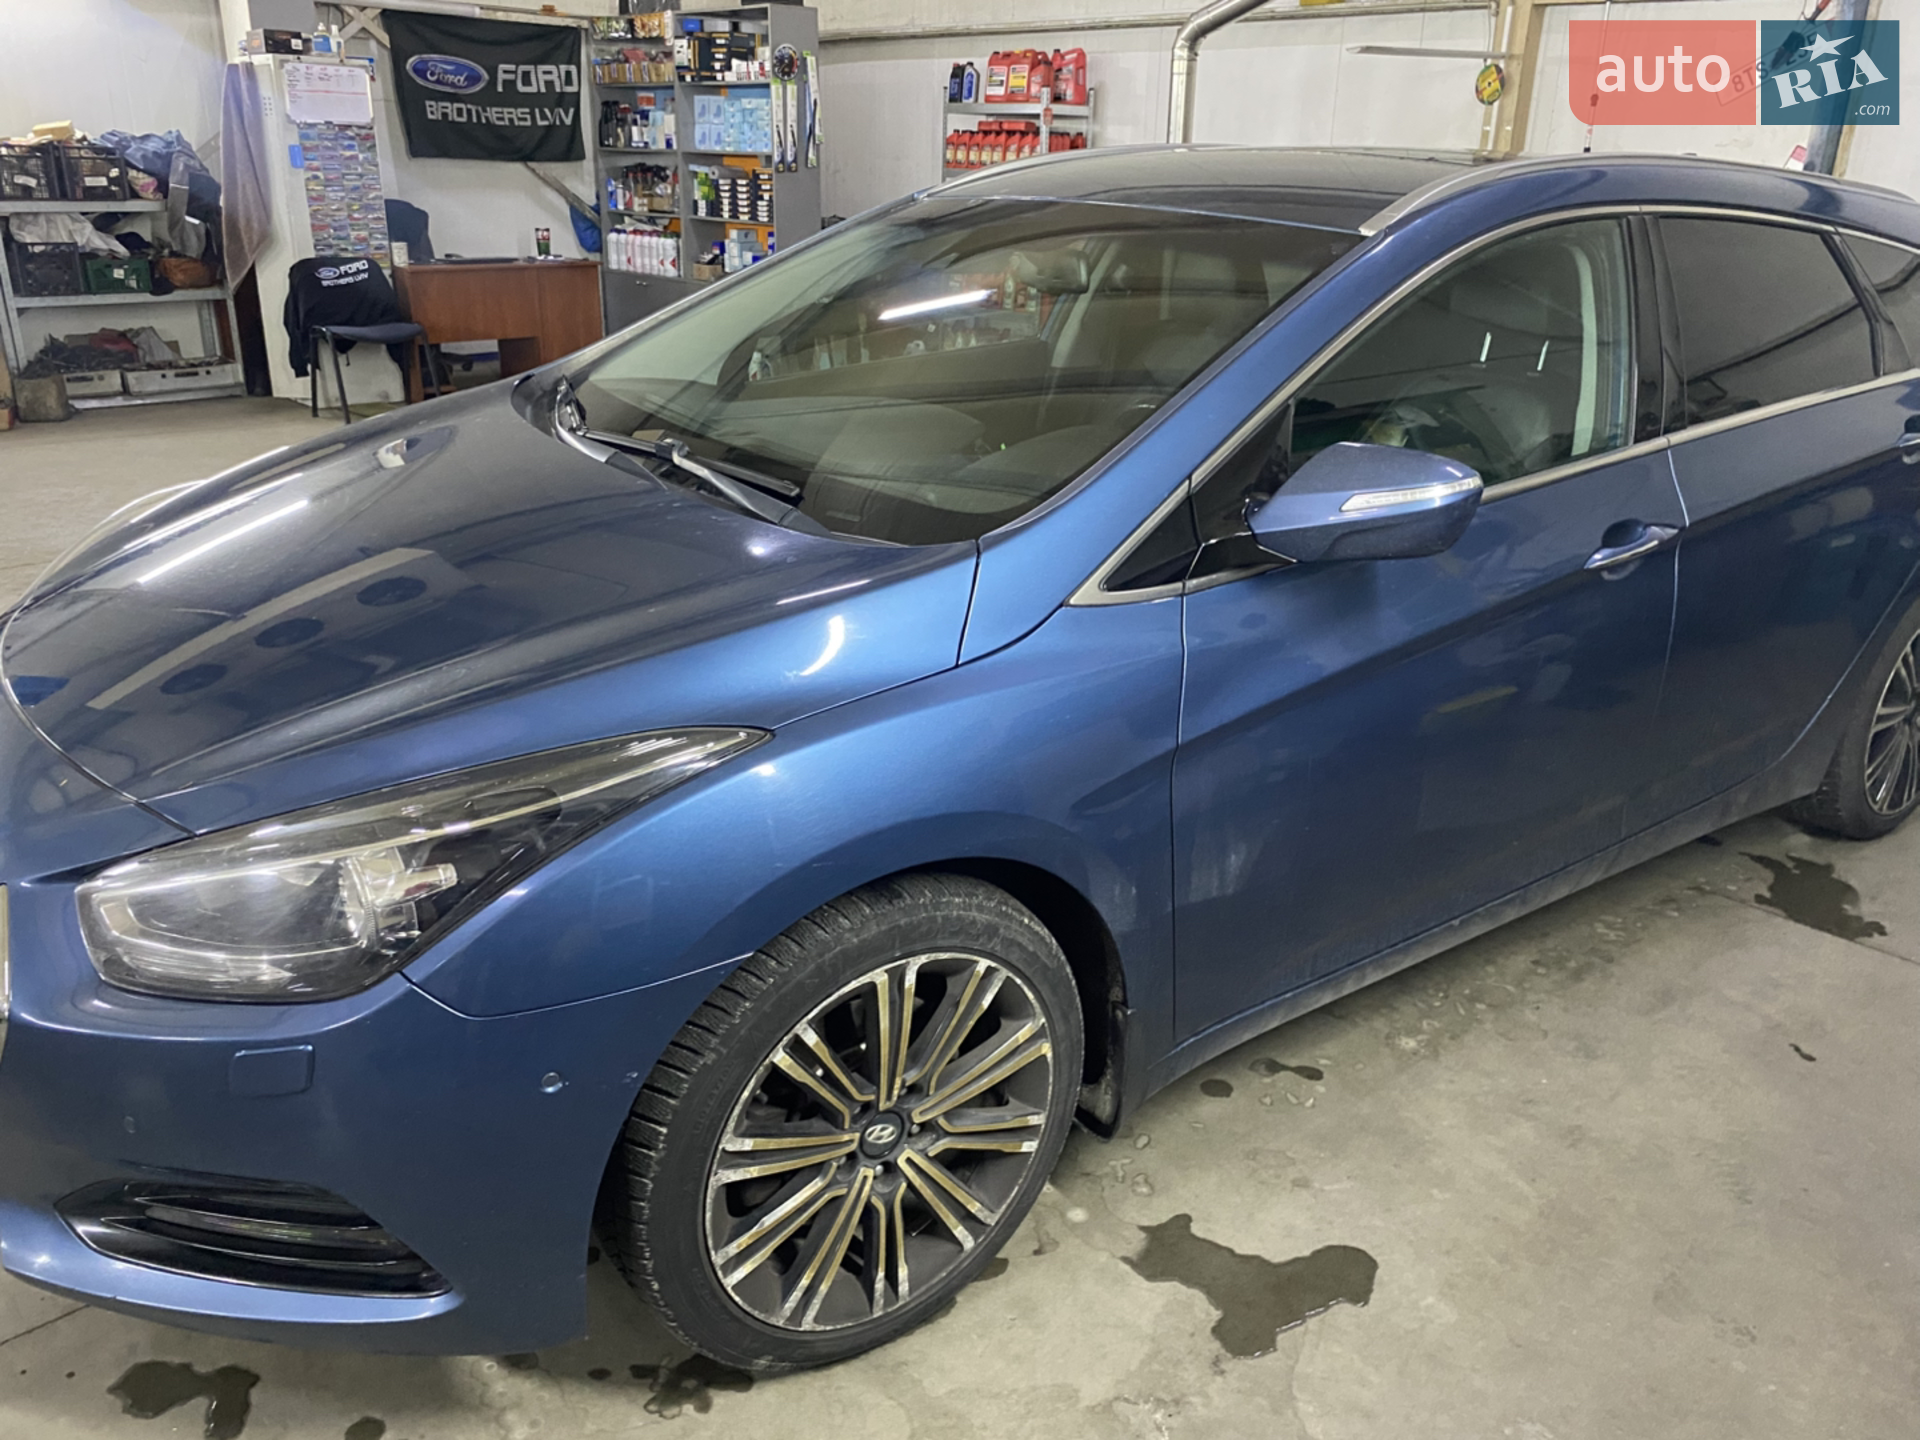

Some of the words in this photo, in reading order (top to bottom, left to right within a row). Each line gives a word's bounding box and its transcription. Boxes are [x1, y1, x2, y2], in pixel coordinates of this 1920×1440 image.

[427, 61, 468, 88] Ford
[497, 64, 579, 93] FORD
[425, 100, 532, 126] BROTHERS
[534, 107, 575, 126] LVIV
[339, 259, 369, 275] FORD
